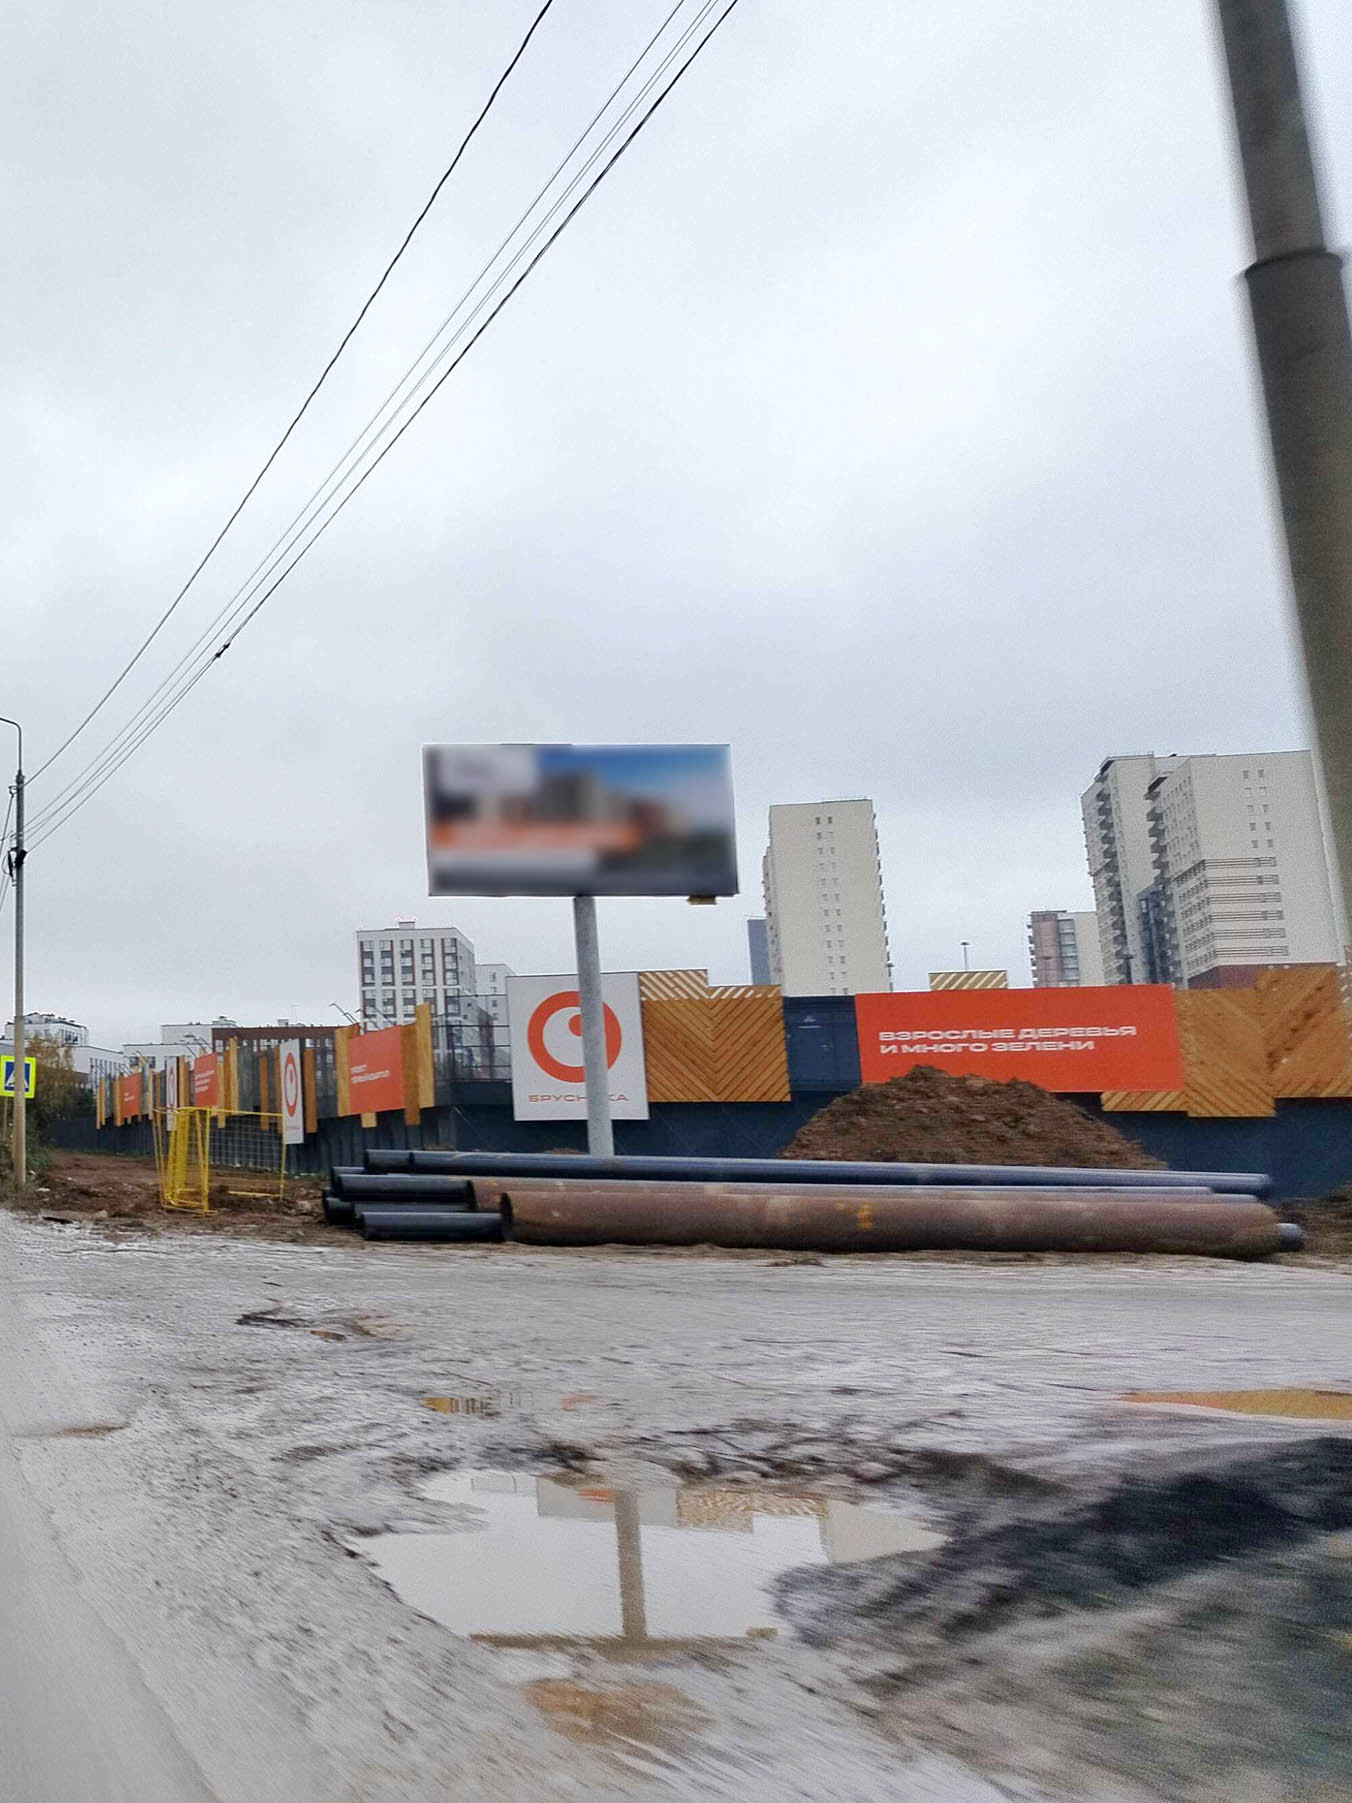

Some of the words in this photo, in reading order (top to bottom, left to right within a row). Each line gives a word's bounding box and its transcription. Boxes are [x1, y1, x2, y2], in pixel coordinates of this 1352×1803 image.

[878, 1028, 1015, 1041] ВЗРОСЛЫЕ
[1018, 1026, 1137, 1040] ДЕРЕВЬЯ
[880, 1044, 898, 1054] И
[901, 1042, 988, 1054] МНОГО
[991, 1040, 1095, 1052] ЗЕЛЕНИ
[528, 1093, 630, 1103] БРУСНКА
